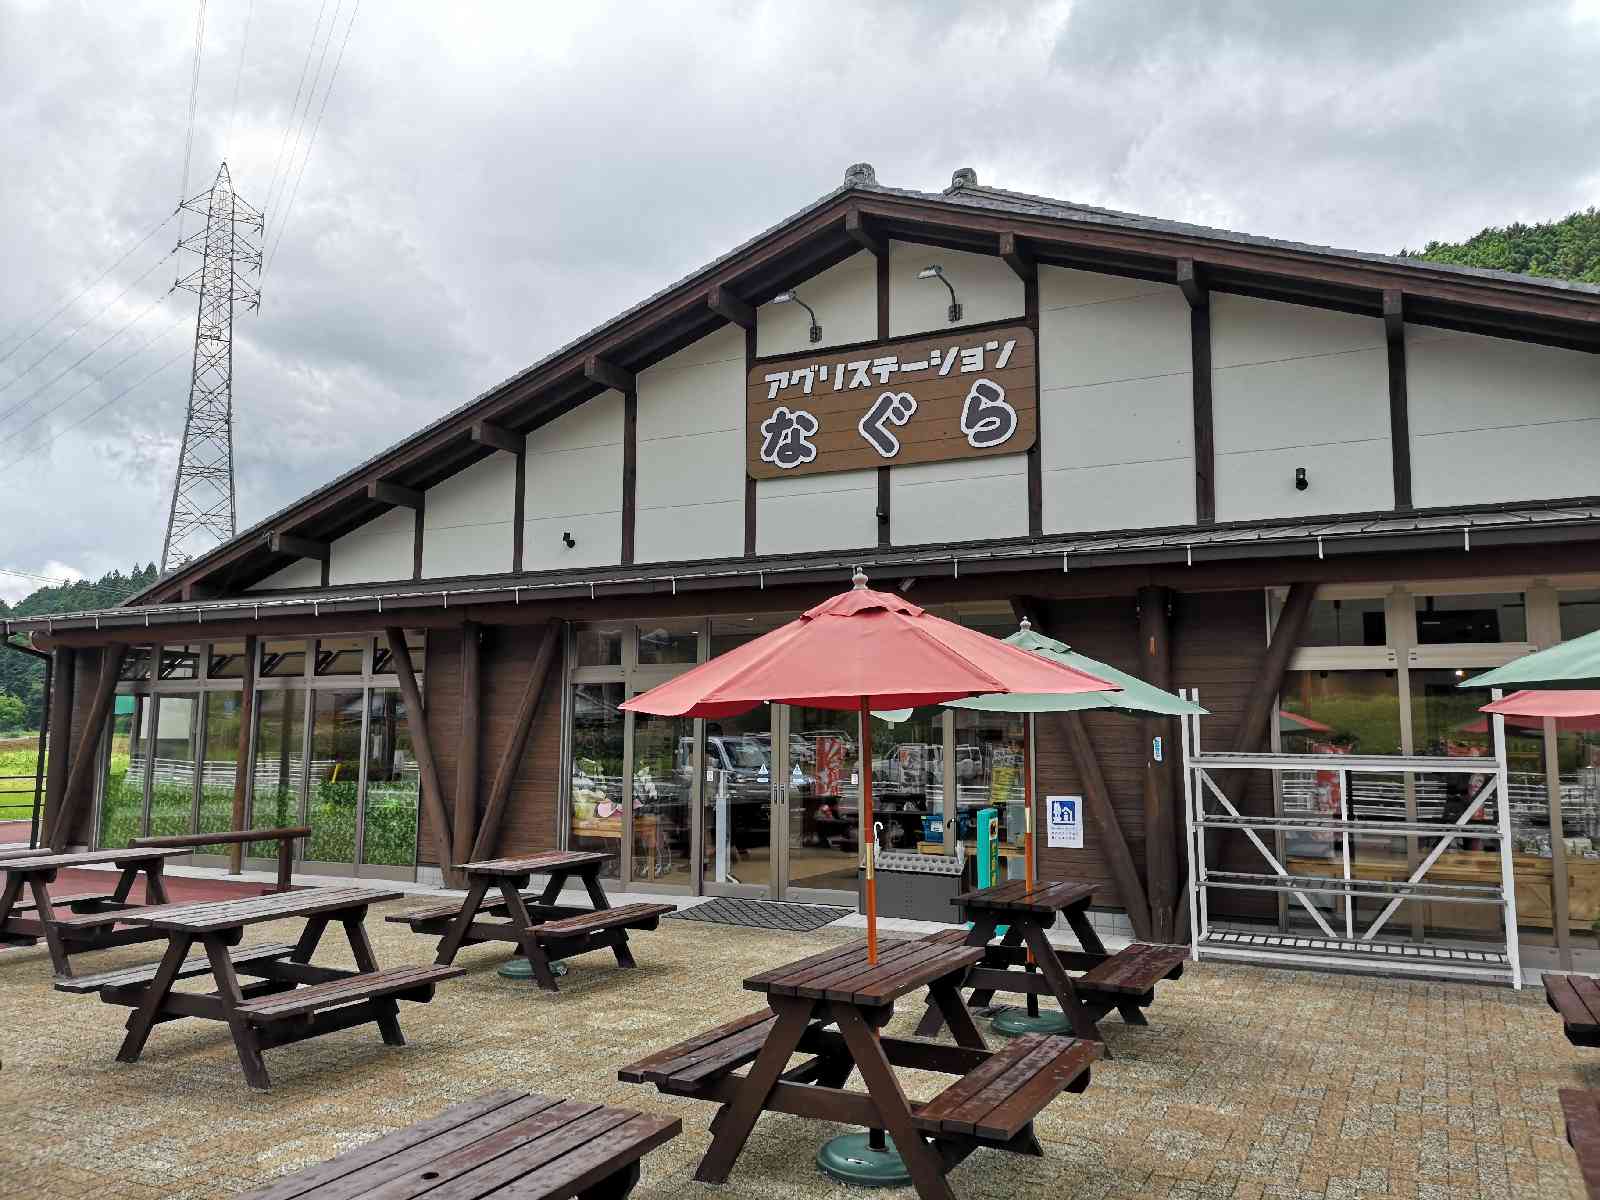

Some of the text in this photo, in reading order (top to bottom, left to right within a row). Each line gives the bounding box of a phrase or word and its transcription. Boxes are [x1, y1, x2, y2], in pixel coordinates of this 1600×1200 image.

[765, 340, 1016, 399] アグリステーション
[760, 378, 1017, 468] なぐら
